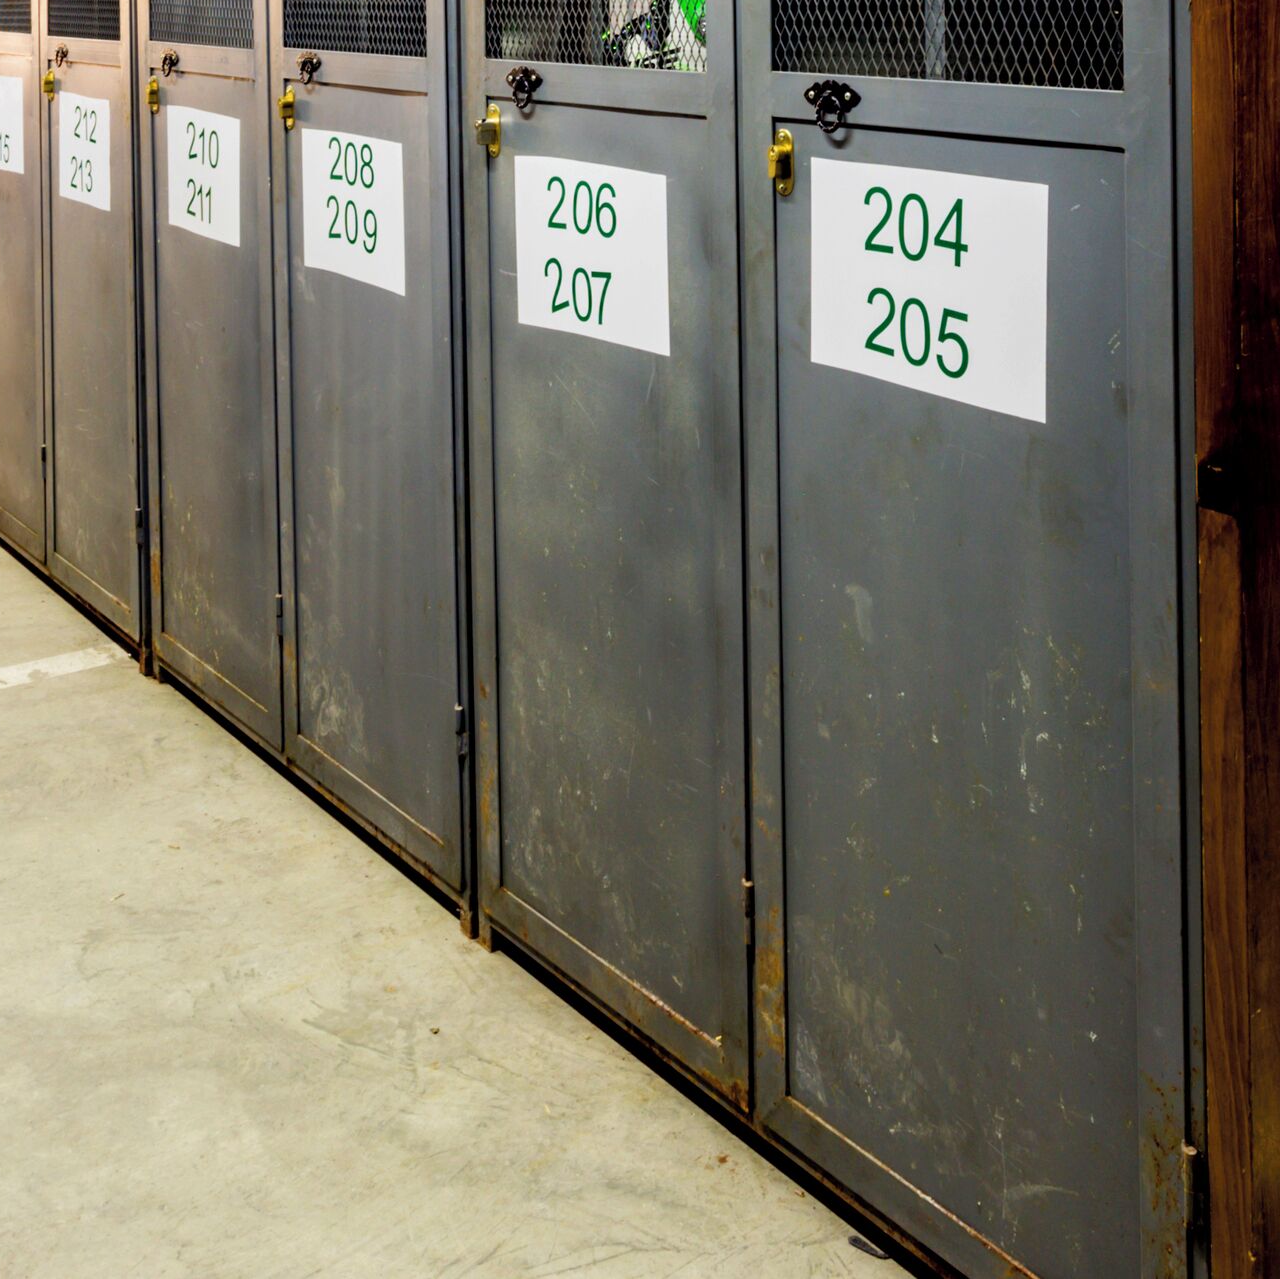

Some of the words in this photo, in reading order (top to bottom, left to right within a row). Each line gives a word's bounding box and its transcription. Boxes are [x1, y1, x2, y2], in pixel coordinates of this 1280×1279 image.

[73, 105, 98, 144] 212
[186, 121, 219, 169] 210
[70, 155, 94, 194] 213
[328, 136, 375, 189] 208
[186, 178, 212, 224] 211
[326, 195, 378, 254] 209
[546, 176, 617, 239] 206
[863, 186, 969, 268] 204
[544, 257, 612, 326] 207
[863, 287, 969, 380] 205
